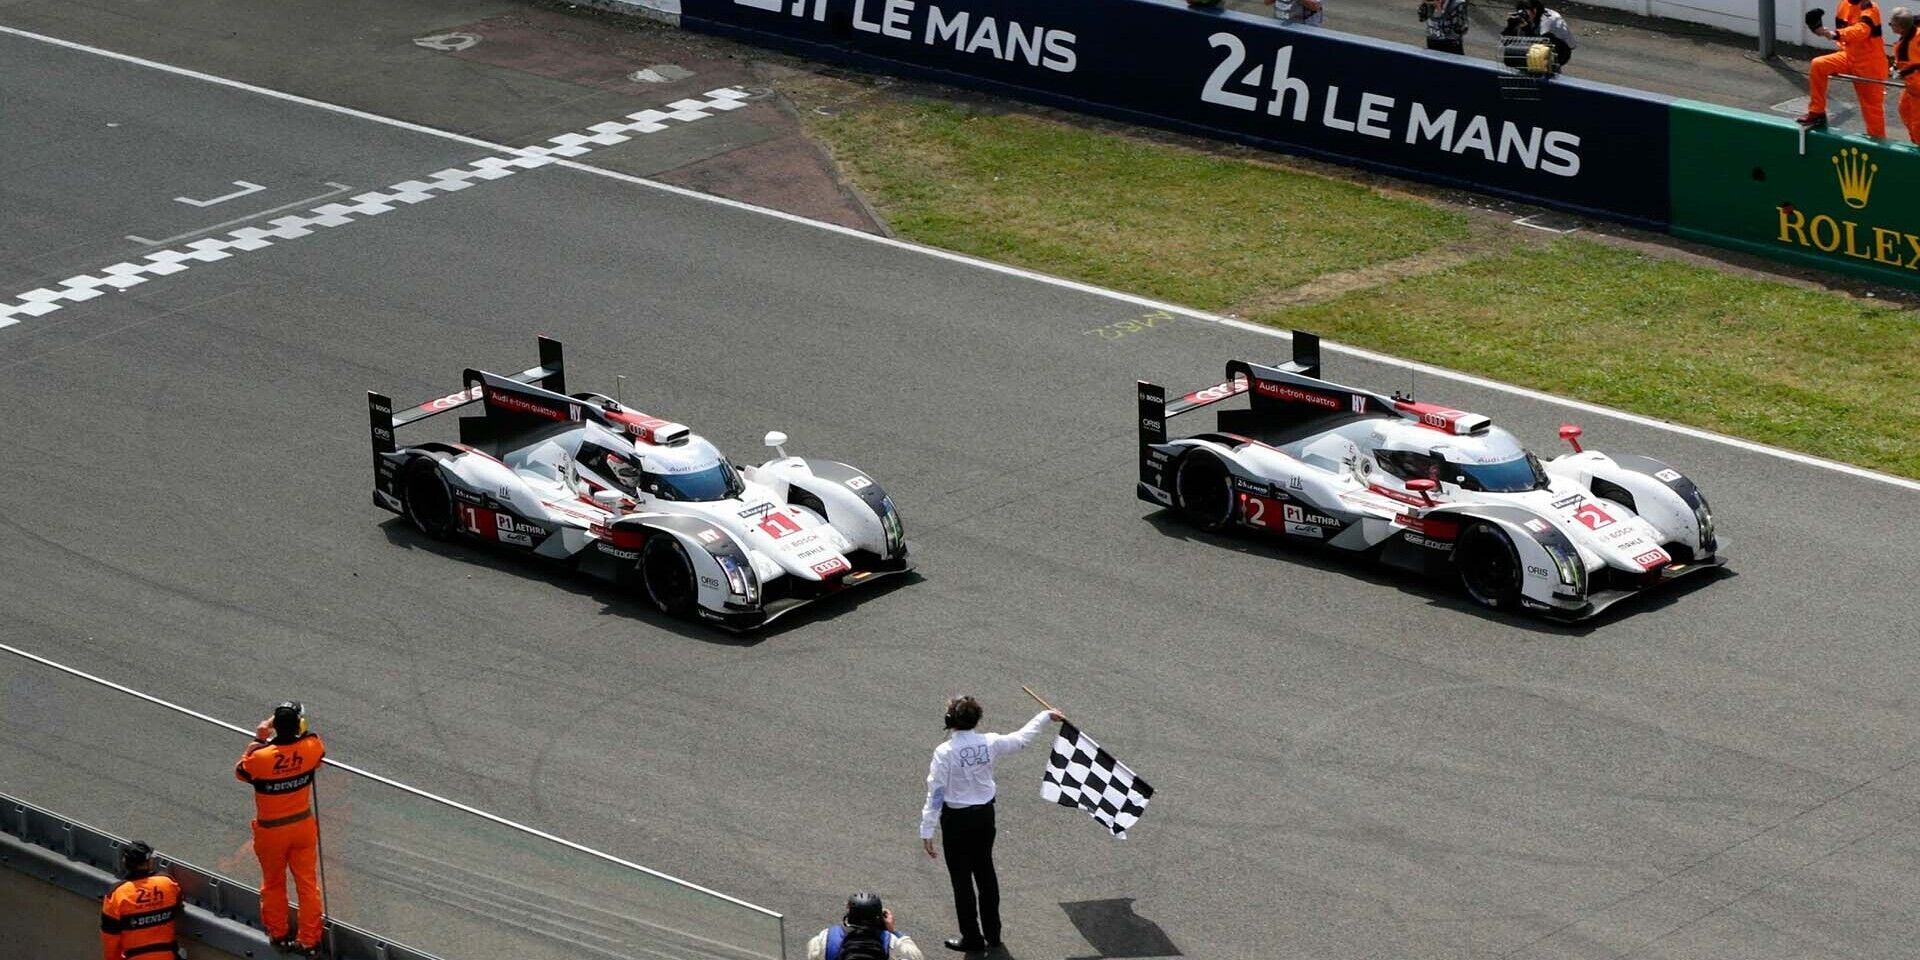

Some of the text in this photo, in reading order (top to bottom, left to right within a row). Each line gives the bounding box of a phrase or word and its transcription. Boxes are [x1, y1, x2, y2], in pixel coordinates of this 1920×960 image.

[852, 0, 915, 40] LE
[924, 5, 1077, 73] MANS
[1201, 32, 1581, 177] 24h LE MANS
[1259, 382, 1335, 408] Audi e-tron quattro
[1352, 394, 1366, 414] HY
[491, 392, 557, 418] Audi e-tron quattro
[569, 403, 582, 422] HY
[466, 507, 481, 534] 1
[1250, 498, 1266, 526] 2
[1287, 507, 1301, 521] P1
[1305, 513, 1341, 527] AETHRA
[1579, 510, 1612, 530] 2
[515, 522, 546, 536] AETHRA
[765, 519, 795, 538] 1
[614, 548, 640, 560] EDGE
[1527, 565, 1548, 576] ORIS
[701, 575, 719, 586] ORIS
[273, 774, 310, 791] DUNLOP
[138, 911, 171, 926] DUNLOP
